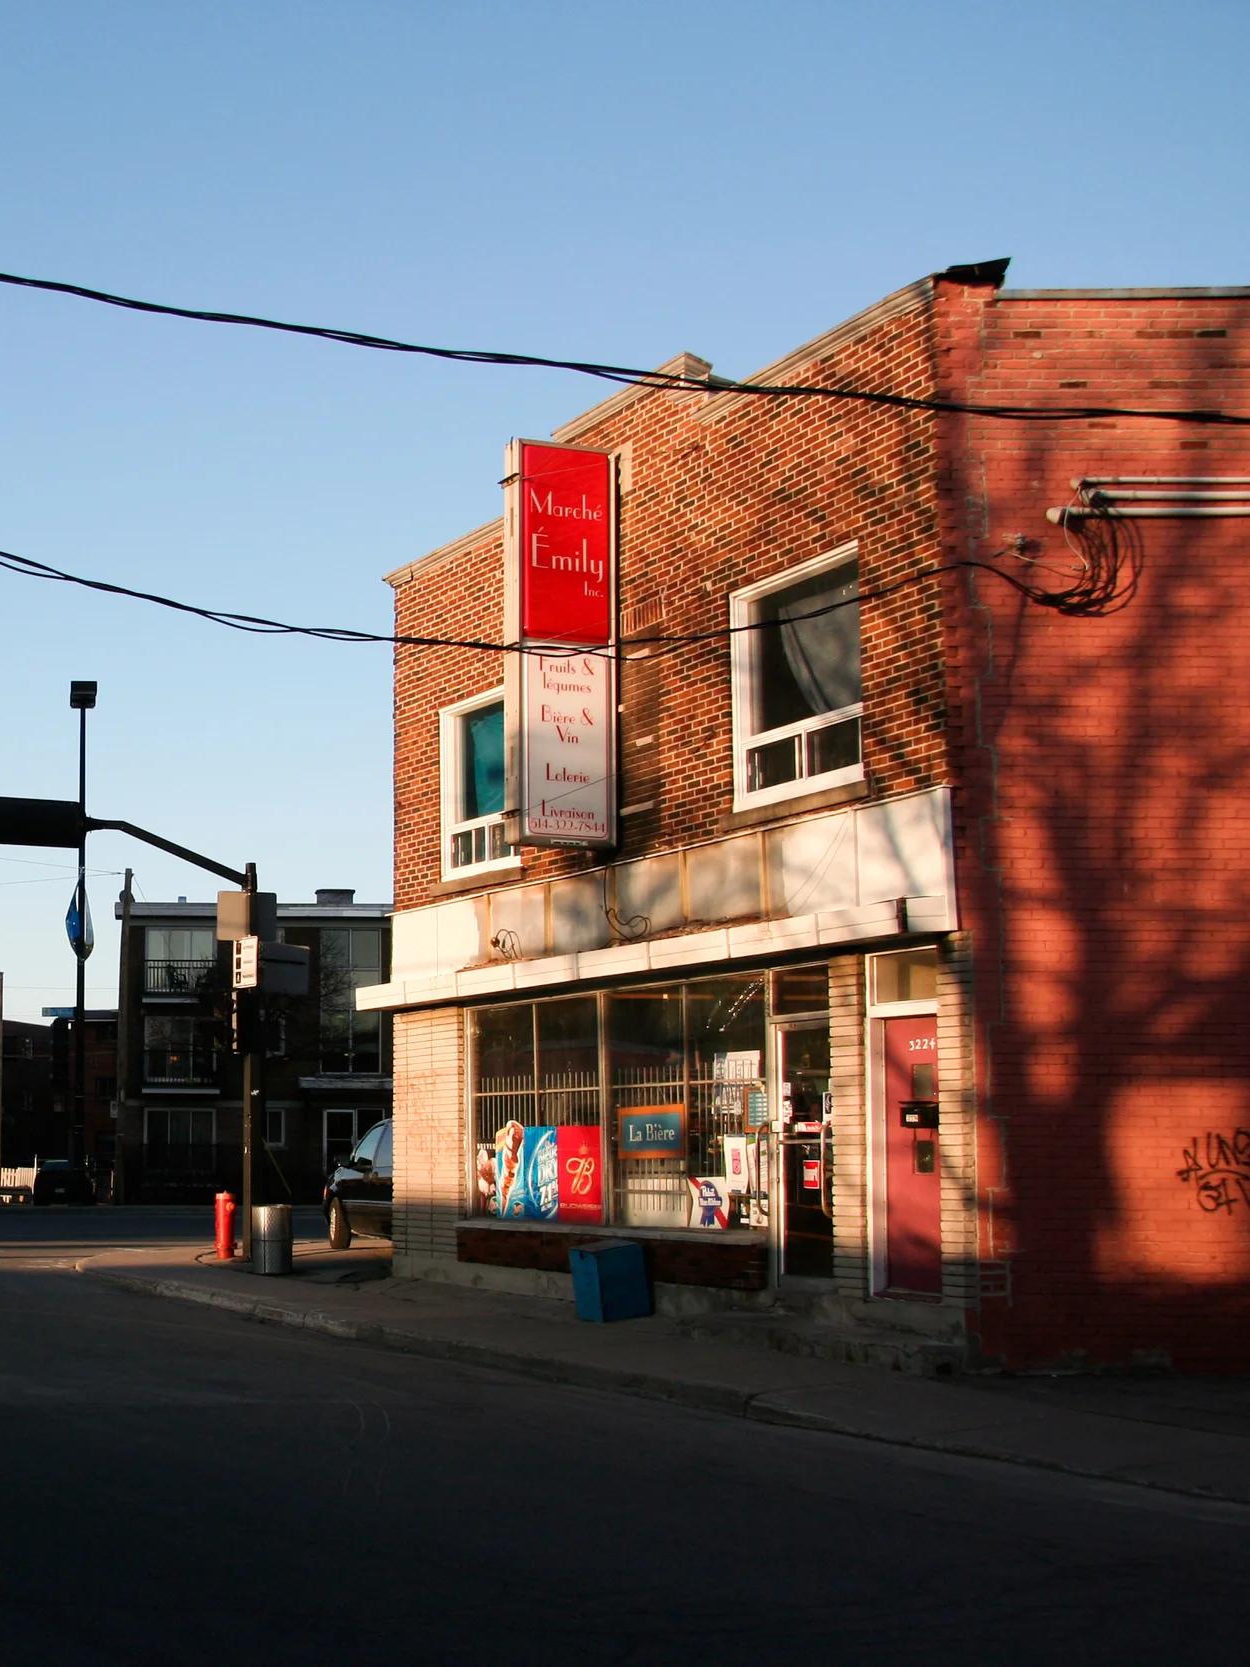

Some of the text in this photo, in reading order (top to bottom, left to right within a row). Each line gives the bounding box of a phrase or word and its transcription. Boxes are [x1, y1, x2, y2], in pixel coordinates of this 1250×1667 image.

[530, 488, 603, 521] Marché
[531, 526, 603, 583] Émily
[584, 581, 604, 597] Inc.
[539, 655, 594, 676] Fruits &
[543, 672, 592, 695] légumes
[541, 704, 594, 726] Bière &
[555, 725, 579, 744] Vin
[546, 762, 589, 783] Loterie
[541, 799, 595, 820] Livraison
[628, 1123, 675, 1142] La Bière
